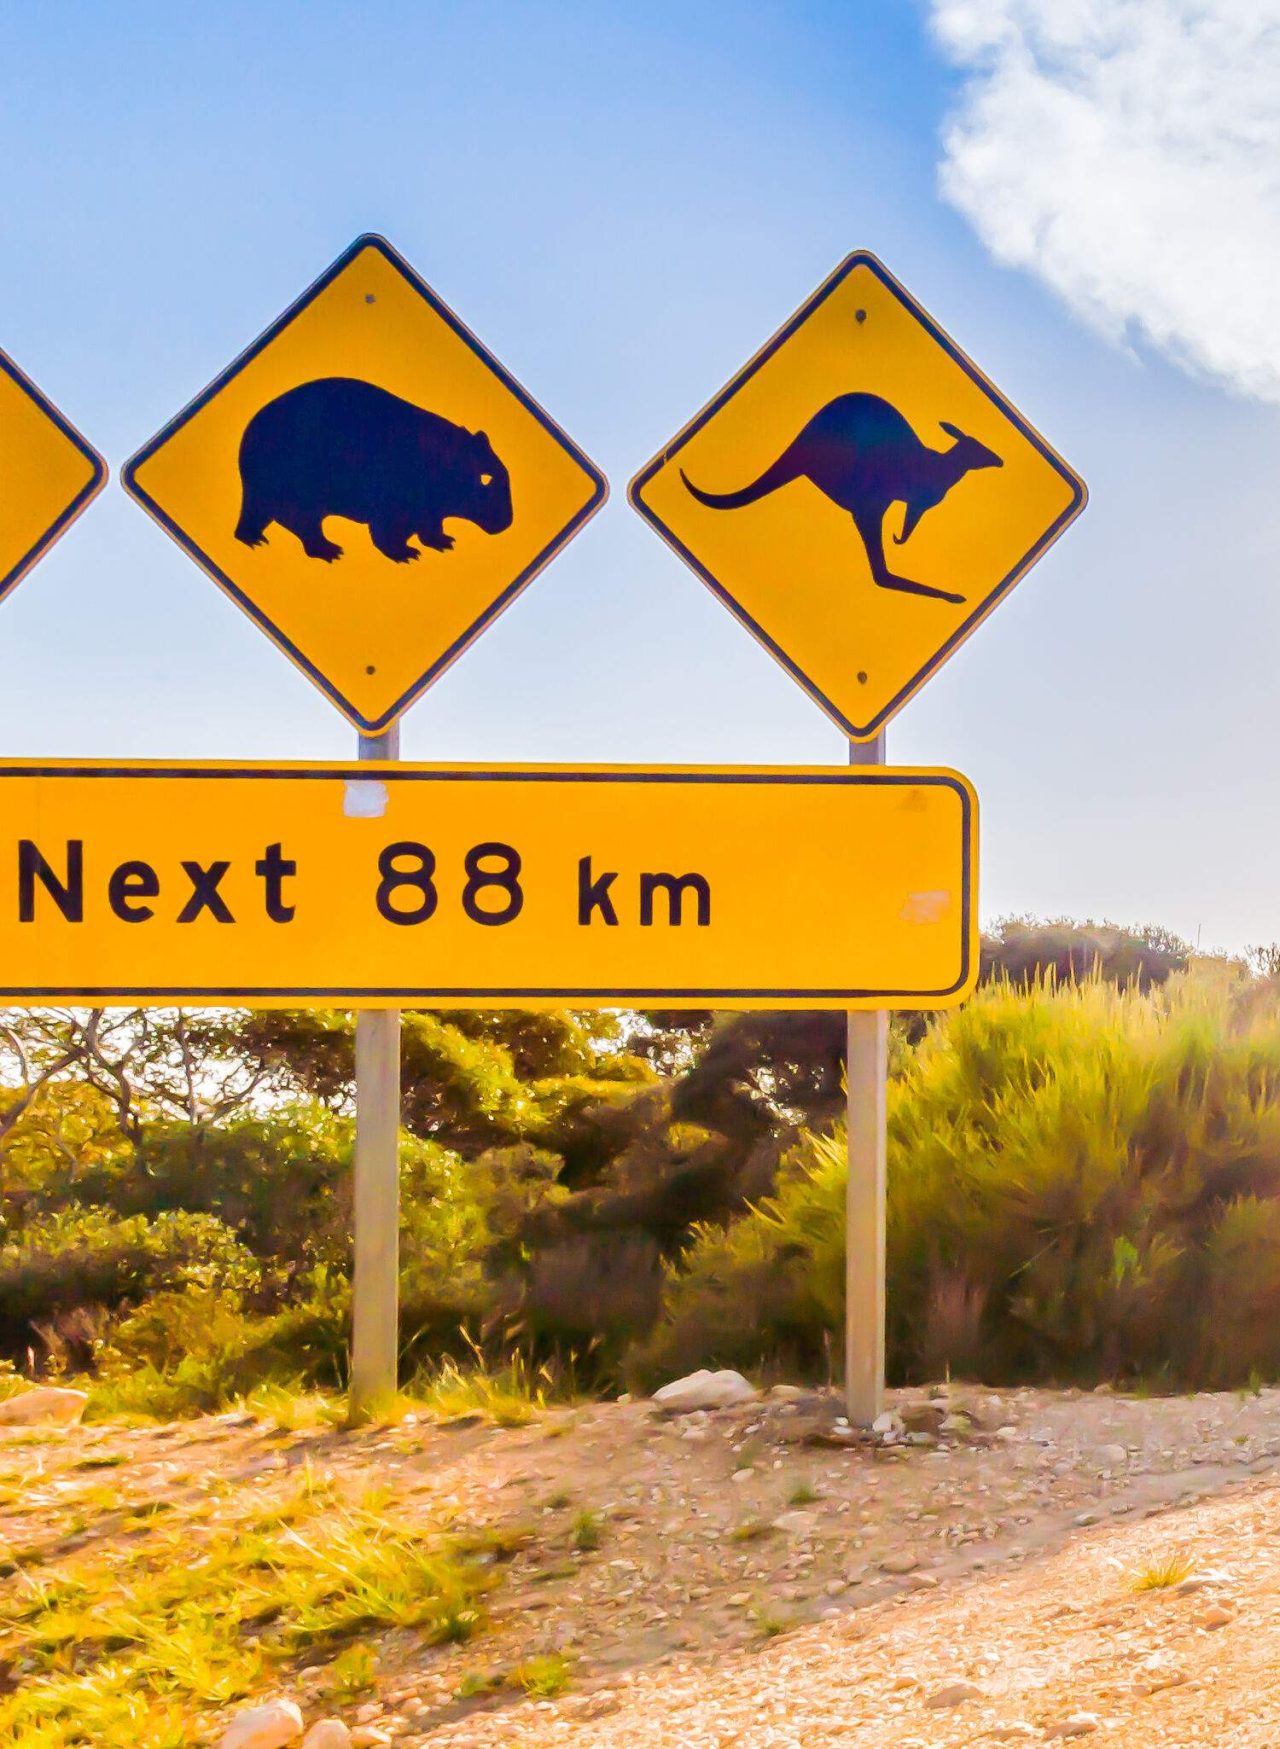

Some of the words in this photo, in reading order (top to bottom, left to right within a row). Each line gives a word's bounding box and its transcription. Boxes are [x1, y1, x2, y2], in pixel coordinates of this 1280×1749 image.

[18, 840, 297, 924] Next
[376, 842, 524, 927] 88
[578, 855, 711, 927] km
